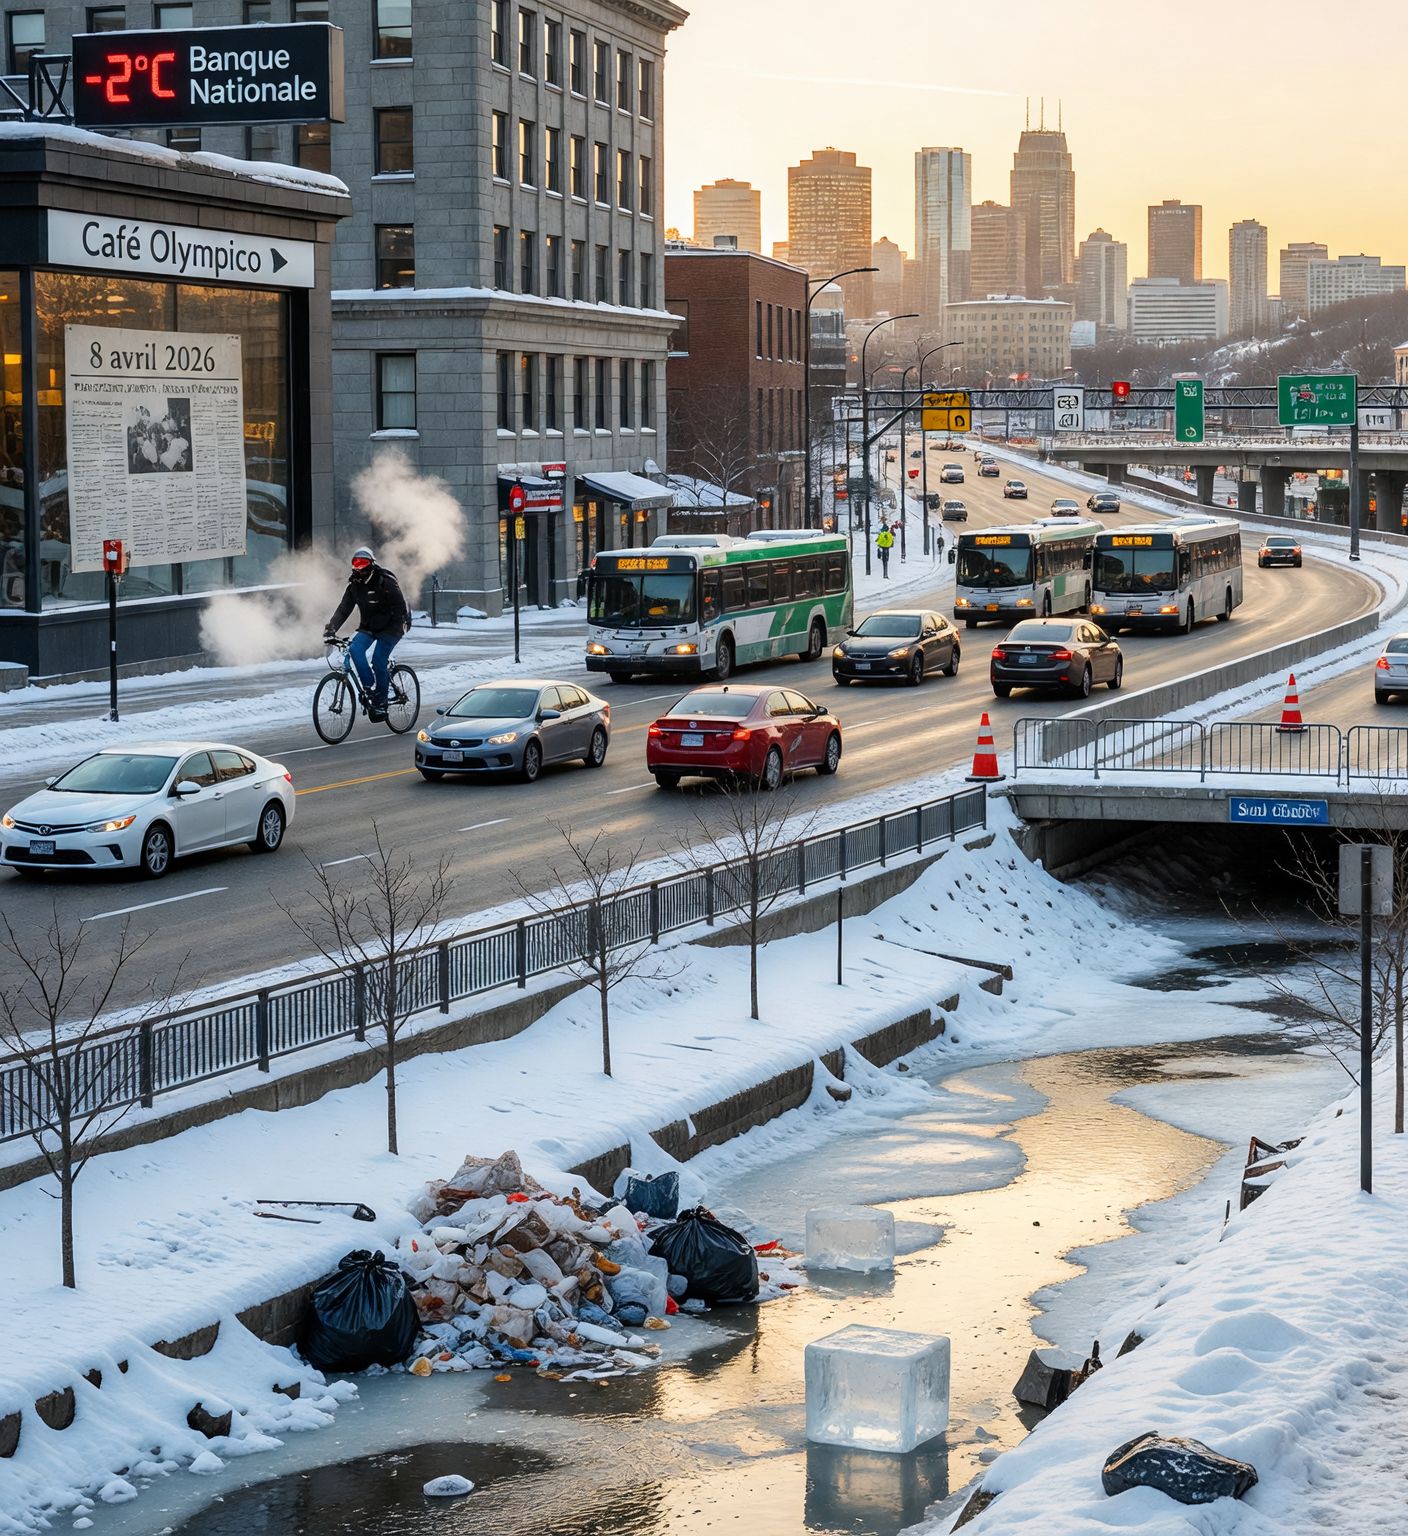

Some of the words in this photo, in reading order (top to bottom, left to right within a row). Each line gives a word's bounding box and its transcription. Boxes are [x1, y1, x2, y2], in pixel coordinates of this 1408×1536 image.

[190, 46, 290, 76] Banque
[86, 52, 175, 102] -2°C
[190, 75, 317, 105] Nationale
[82, 221, 141, 260] Café
[150, 229, 261, 278] Olympico
[90, 341, 102, 369] 8
[110, 343, 156, 371] avril
[165, 345, 215, 372] 2026
